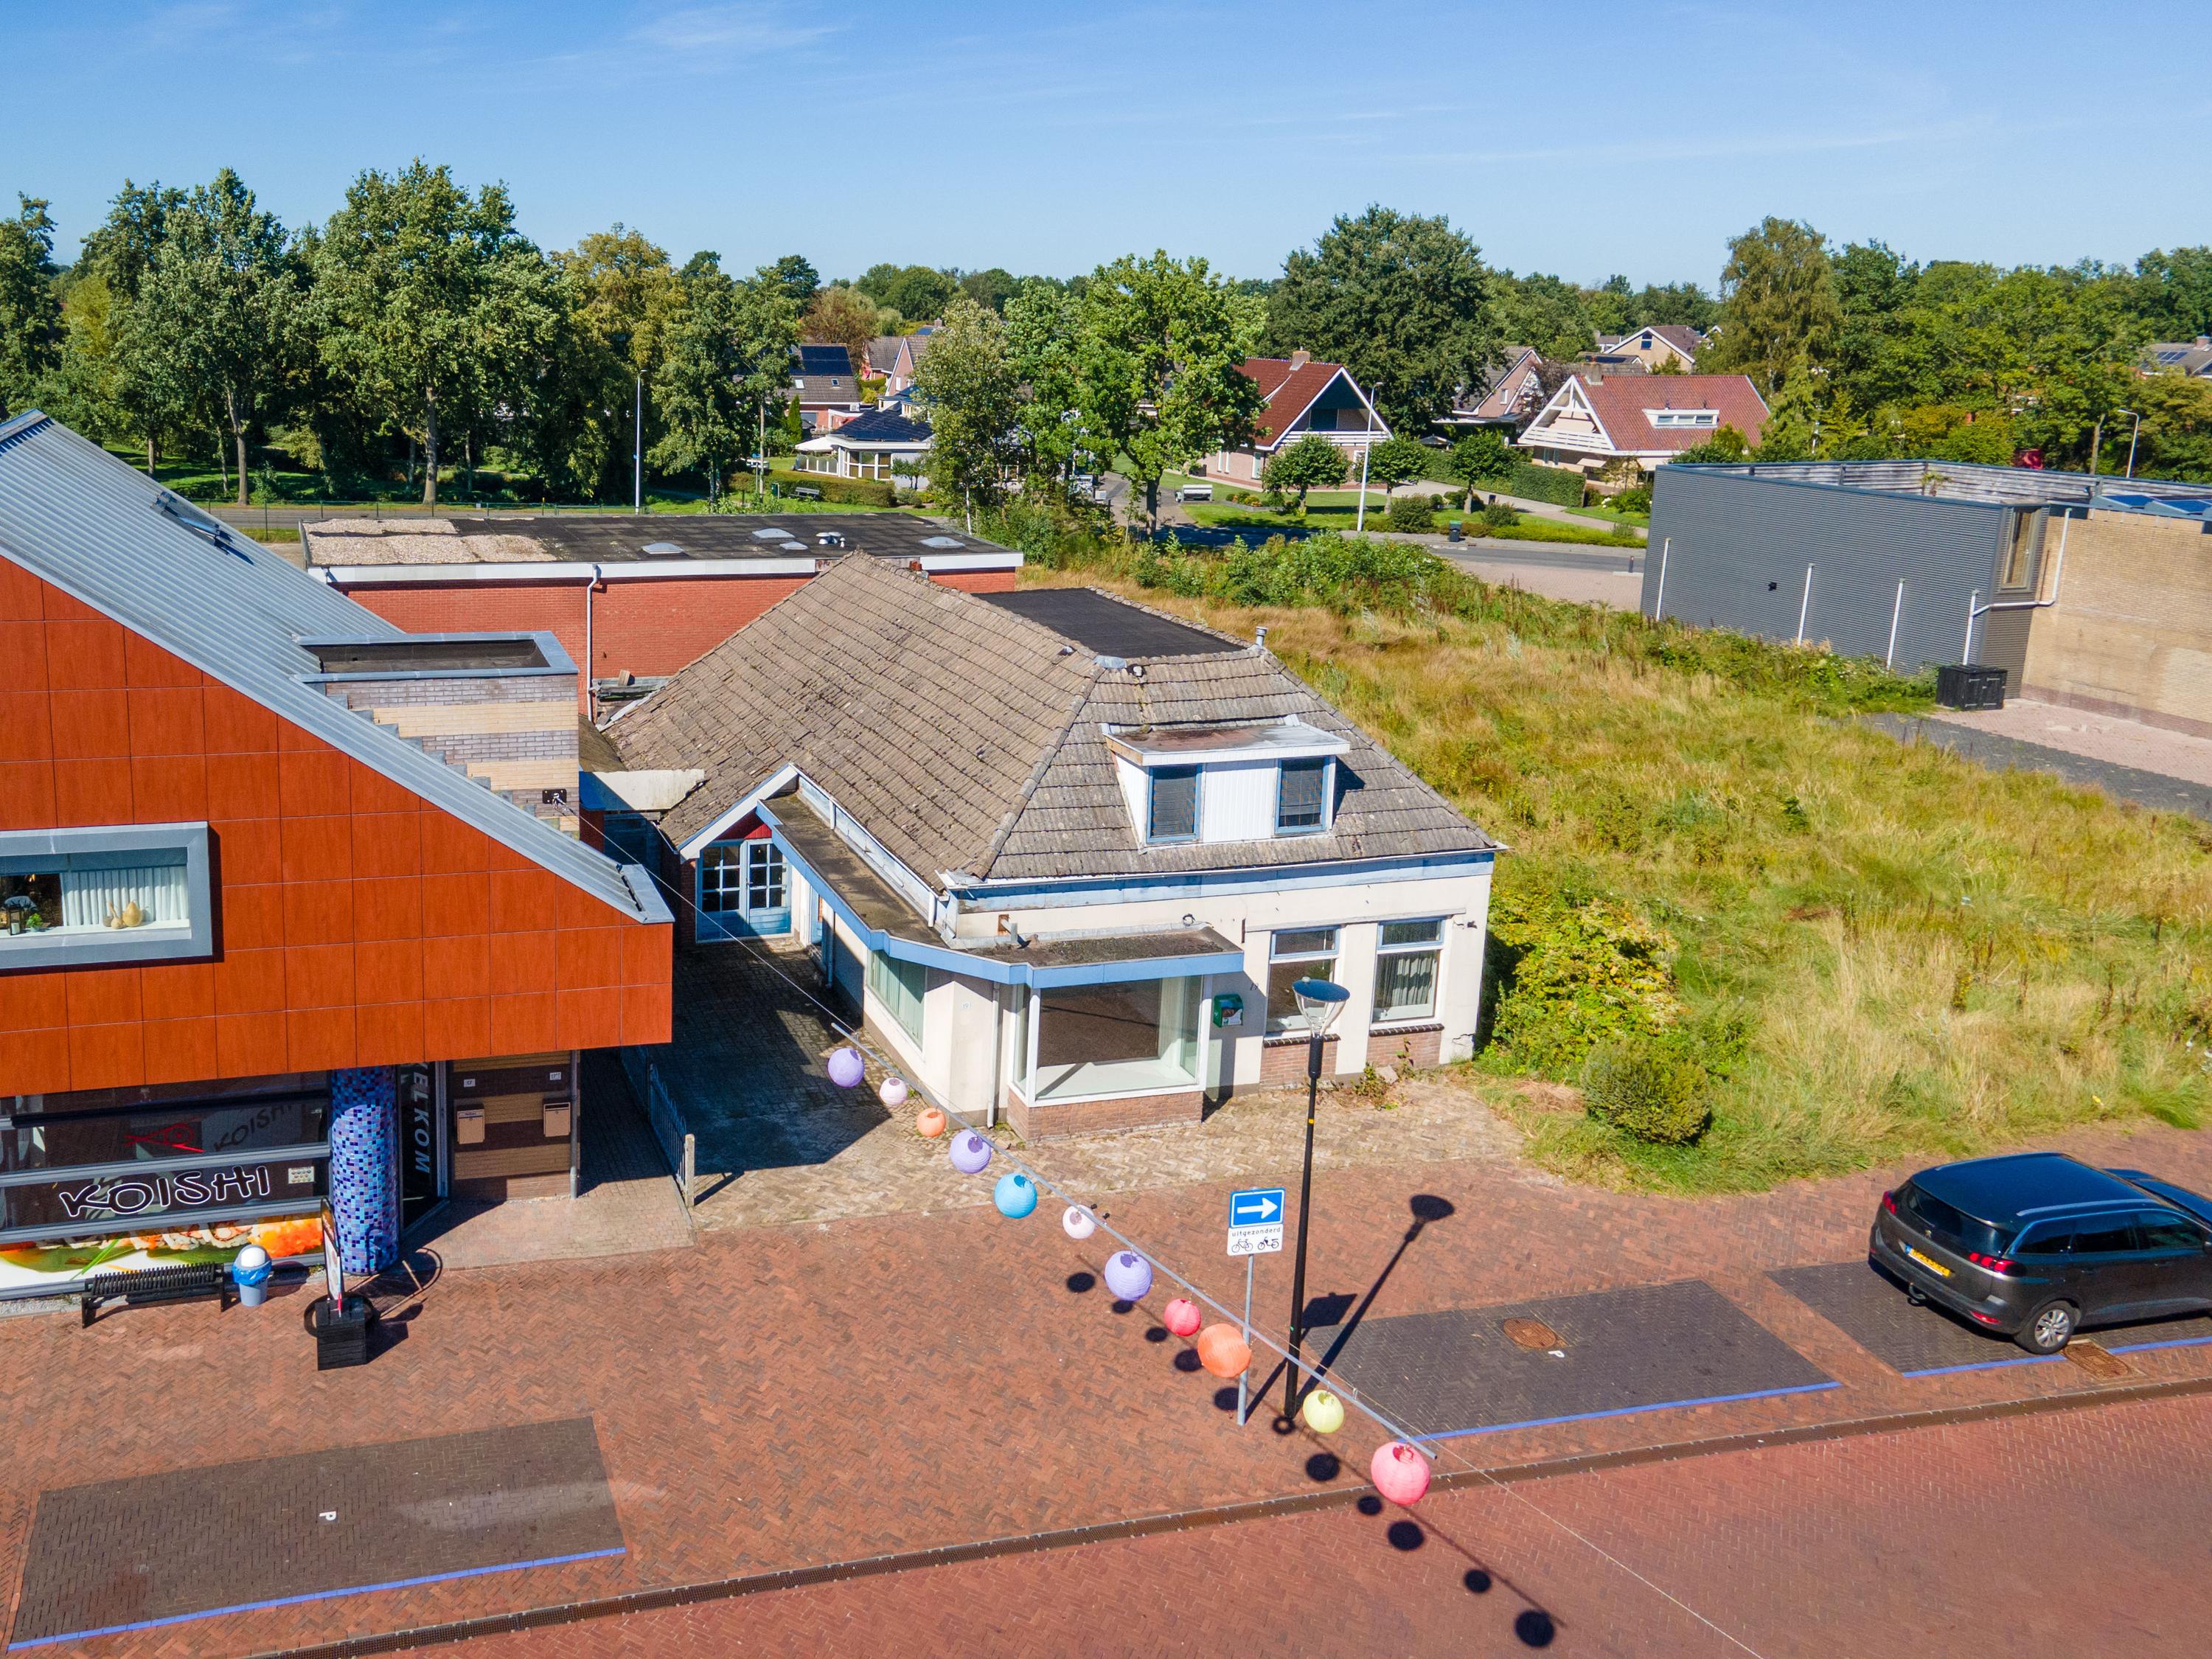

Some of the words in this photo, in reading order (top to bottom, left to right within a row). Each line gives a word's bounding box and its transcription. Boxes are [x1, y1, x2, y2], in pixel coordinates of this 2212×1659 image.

[59, 1164, 270, 1217] KOISHI
[1232, 1227, 1281, 1237] uitgezonderd
[319, 1511, 336, 1520] P
